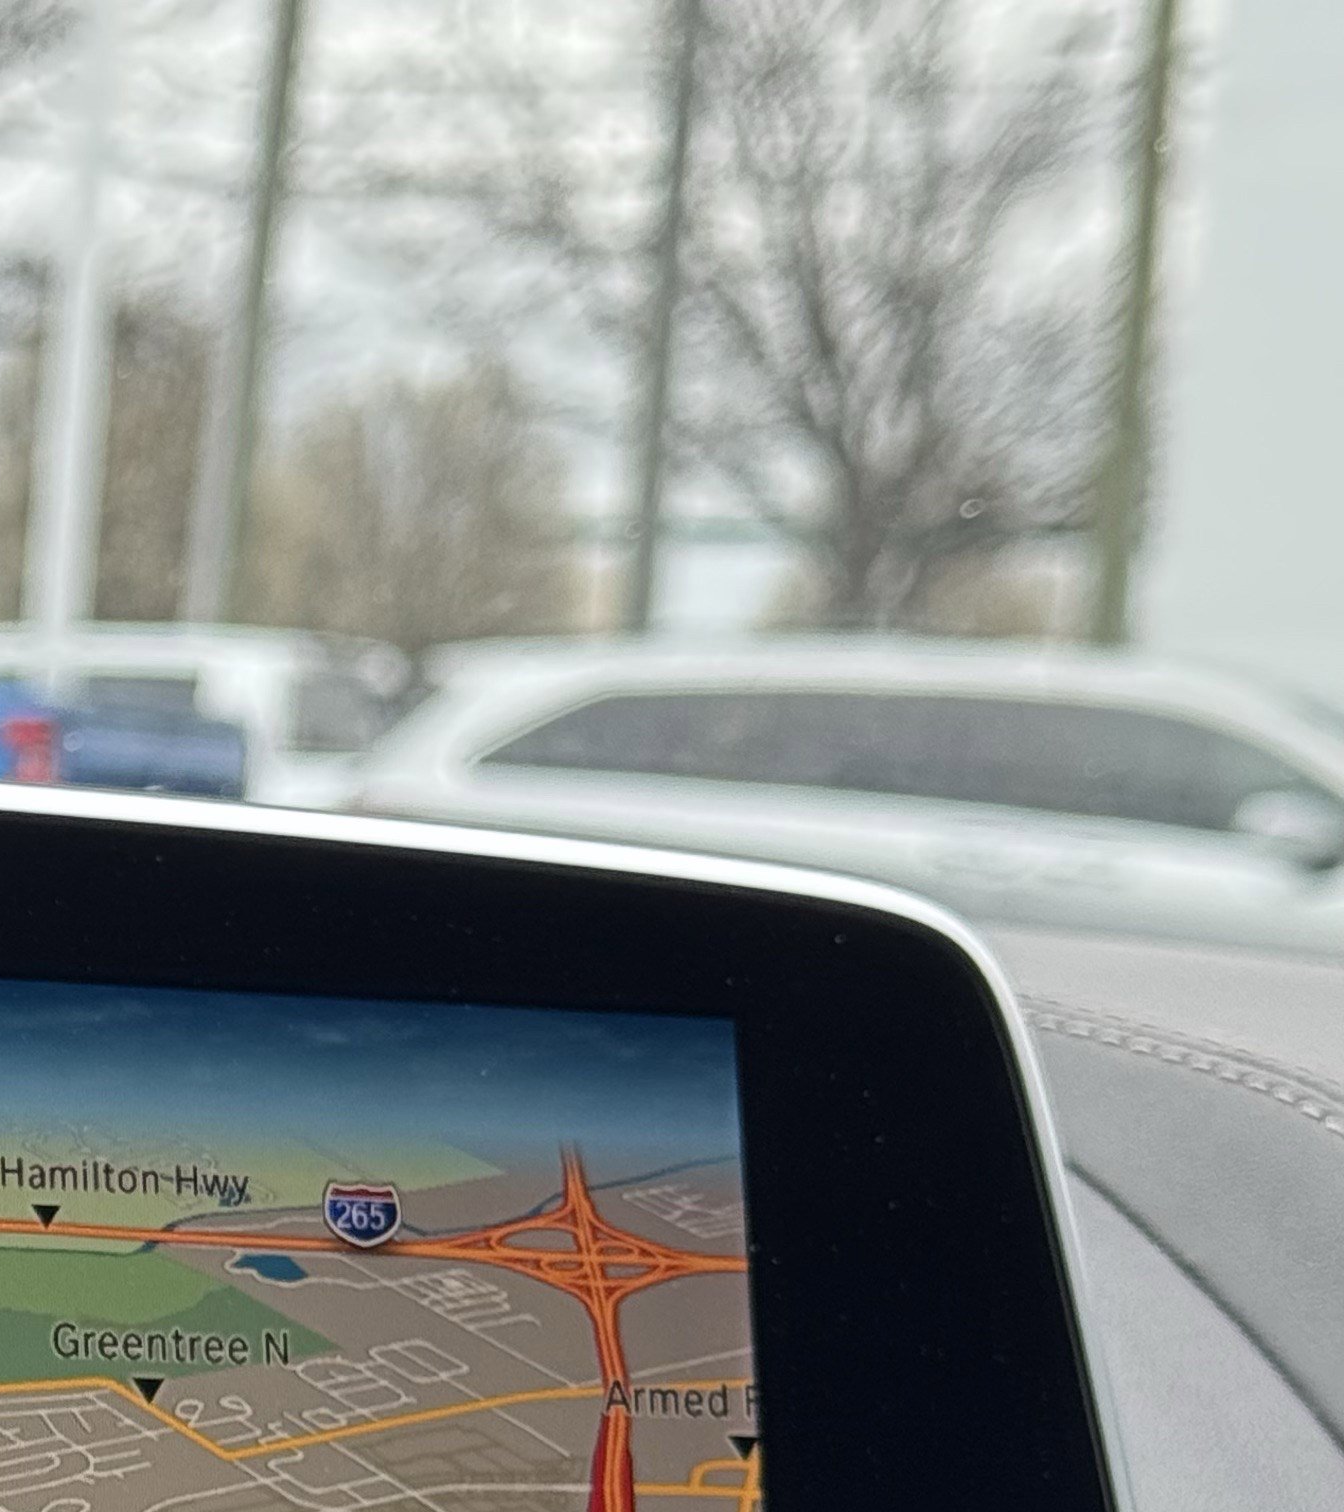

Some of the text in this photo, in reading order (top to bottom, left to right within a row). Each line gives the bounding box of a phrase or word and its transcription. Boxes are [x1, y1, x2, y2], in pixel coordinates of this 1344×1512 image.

[0, 1155, 161, 1195] Hamilton
[175, 1163, 250, 1207] Hwy
[335, 1201, 386, 1231] 265
[52, 1320, 290, 1368] Greentree N
[606, 1379, 729, 1418] Armed
